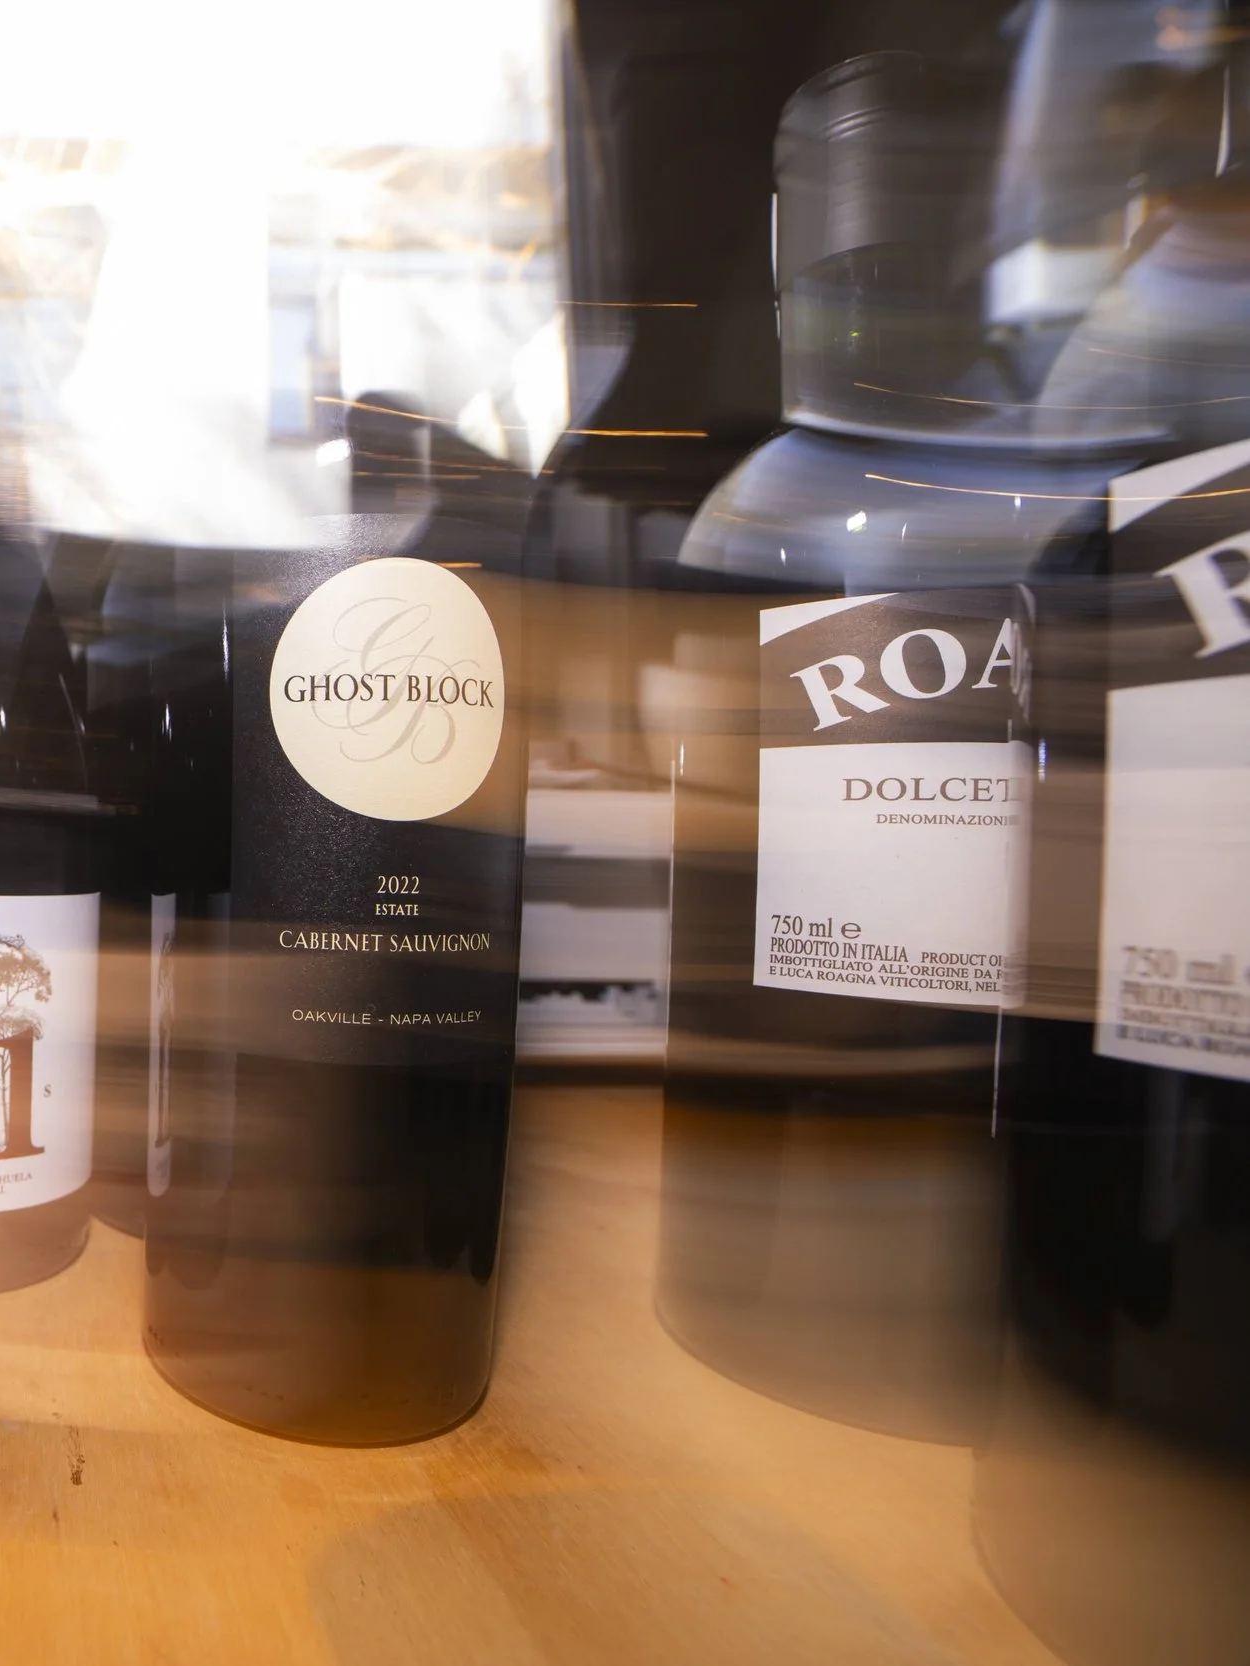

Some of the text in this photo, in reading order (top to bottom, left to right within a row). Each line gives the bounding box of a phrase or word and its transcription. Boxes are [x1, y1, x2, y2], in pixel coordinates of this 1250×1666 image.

[283, 673, 494, 708] GHOST BLOCK
[376, 875, 420, 895] 2022
[375, 903, 420, 917] ESTATE
[770, 914, 803, 936] 750
[809, 917, 833, 939] ml
[279, 930, 491, 953] CABERNET SAUVIGNON
[770, 936, 839, 958] PRODOTTO
[843, 942, 858, 960] IN
[861, 943, 909, 963] ITALIA
[921, 951, 987, 966] PRODUCT
[769, 954, 873, 973] IMBOTTIGLIATO
[878, 962, 969, 979] ALL'ORIGINE
[973, 968, 993, 979] DA
[769, 965, 1001, 992] E LUCA ROAGNA VITICOLTORI, NEL
[291, 1009, 372, 1025] OAKVILLE
[389, 1013, 432, 1025] NAPA
[436, 1010, 482, 1025] VALLEY
[43, 1084, 52, 1098] S
